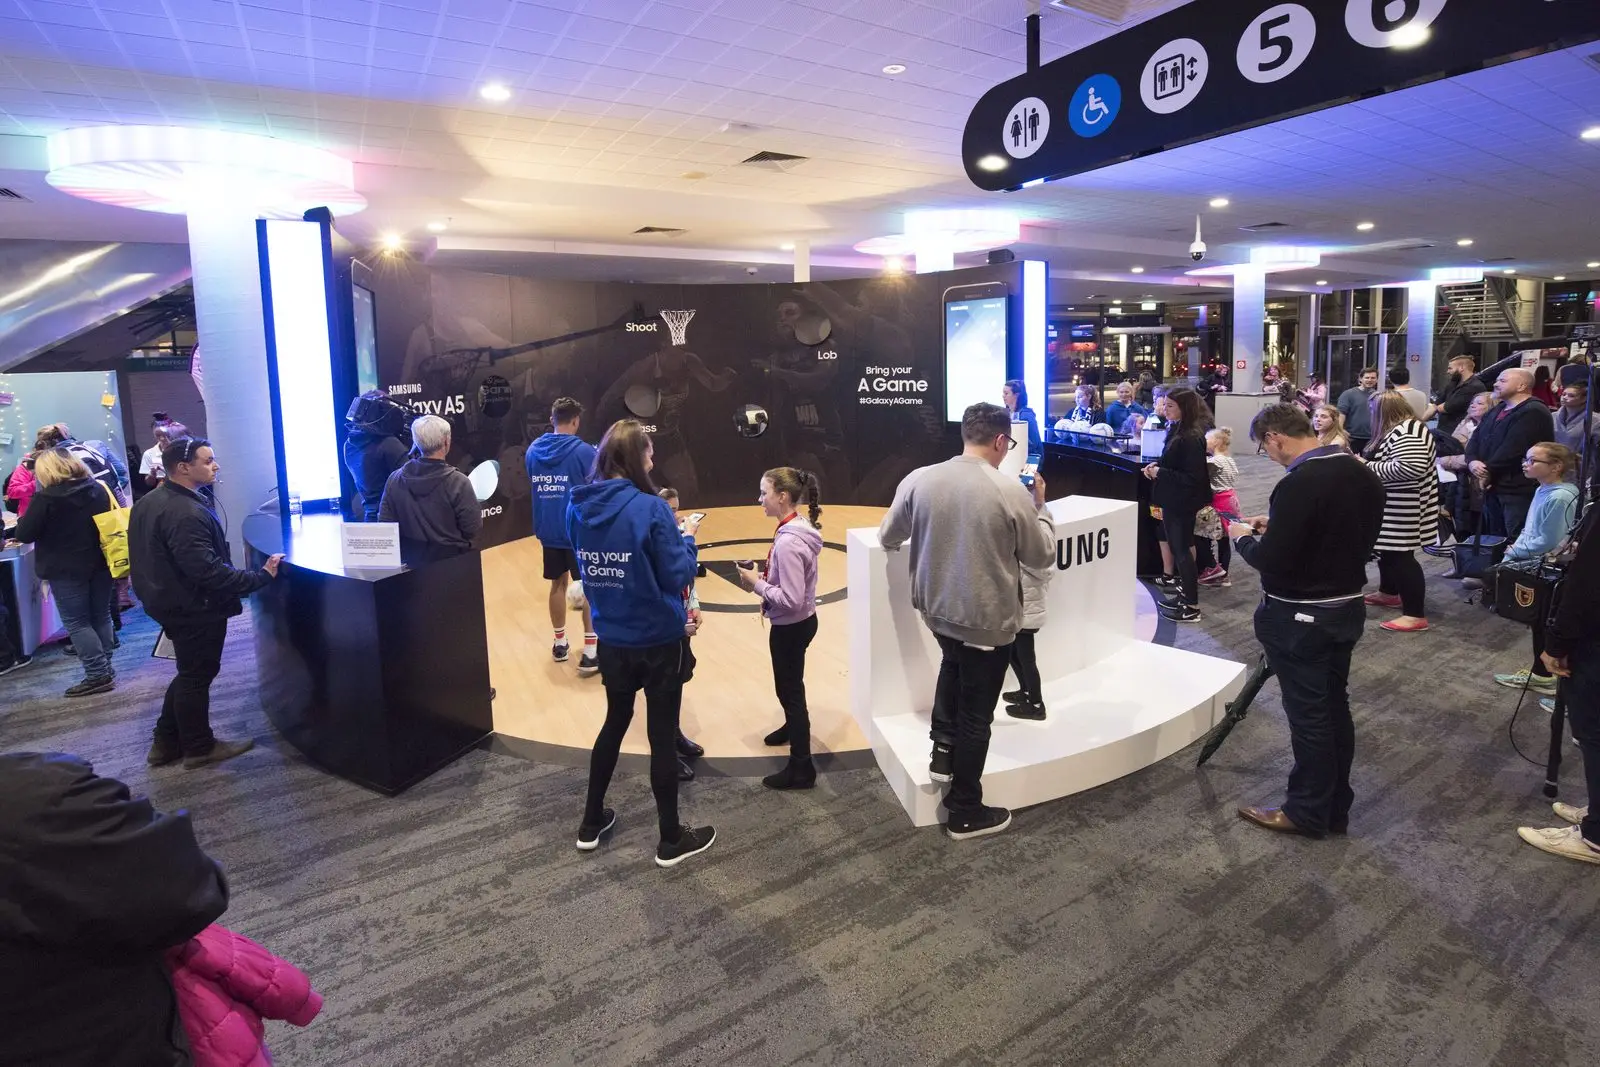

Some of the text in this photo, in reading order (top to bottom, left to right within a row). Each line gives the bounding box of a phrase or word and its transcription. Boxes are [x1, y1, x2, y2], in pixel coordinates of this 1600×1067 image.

[1258, 13, 1293, 72] 5
[625, 322, 657, 331] Shoot
[817, 350, 838, 360] Lob
[866, 366, 912, 376] Bring your
[388, 384, 422, 395] SAMSUNG
[857, 378, 928, 392] A Game
[444, 394, 465, 416] A5
[859, 397, 923, 406] #GalaxyAGame
[640, 424, 657, 433] ass
[532, 474, 569, 484] Bring your
[537, 484, 566, 492] A Game
[1056, 527, 1109, 571] UNG
[601, 551, 632, 565] your
[587, 565, 625, 579] Game
